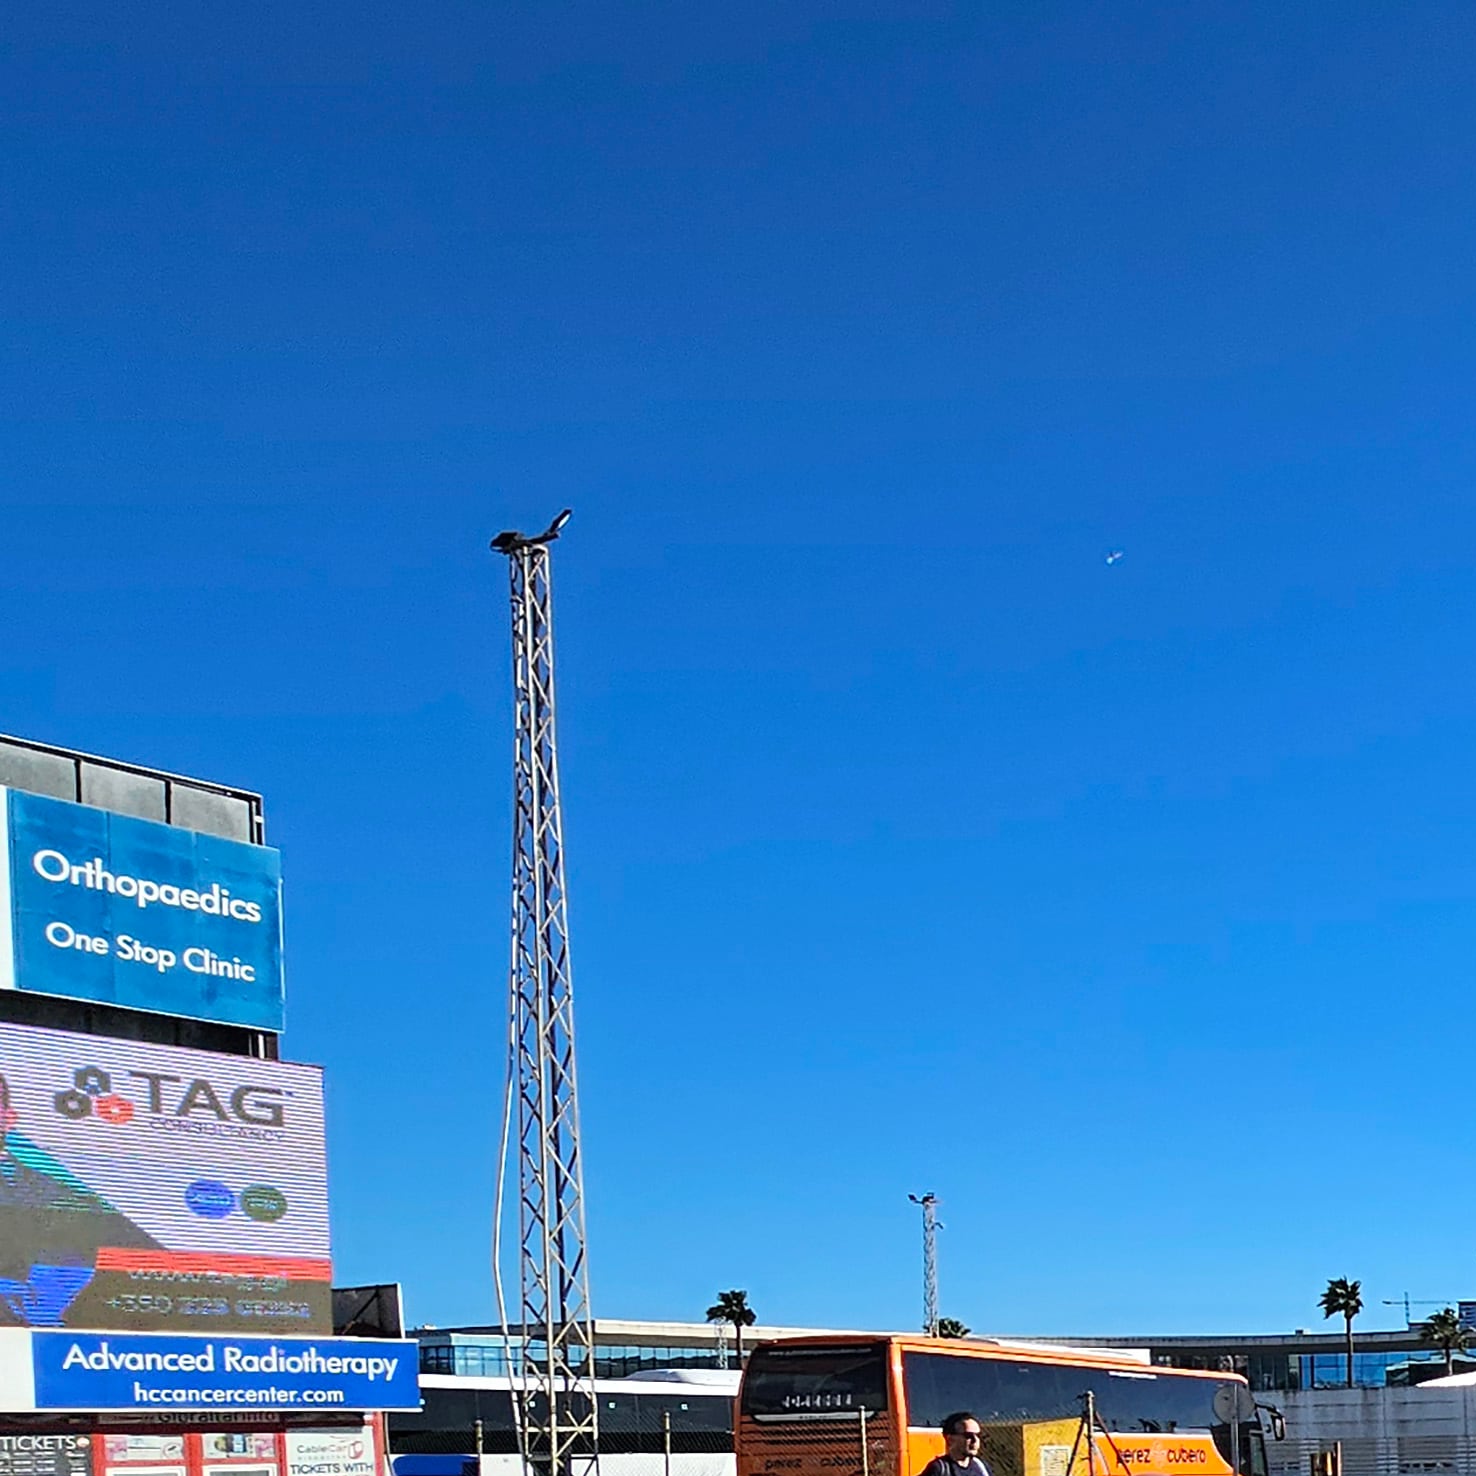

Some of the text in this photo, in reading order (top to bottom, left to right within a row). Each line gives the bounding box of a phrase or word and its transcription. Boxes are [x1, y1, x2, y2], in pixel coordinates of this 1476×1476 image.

[33, 849, 262, 922] Orthopaedics
[45, 921, 256, 983] One Stop Clinic
[127, 1071, 285, 1128] TAG
[62, 1343, 399, 1382] Advanced Radiotherapy
[133, 1382, 345, 1403] hccancercenter.com
[0, 1436, 76, 1450] TICKETS
[290, 1462, 373, 1475] TICKETS WITH
